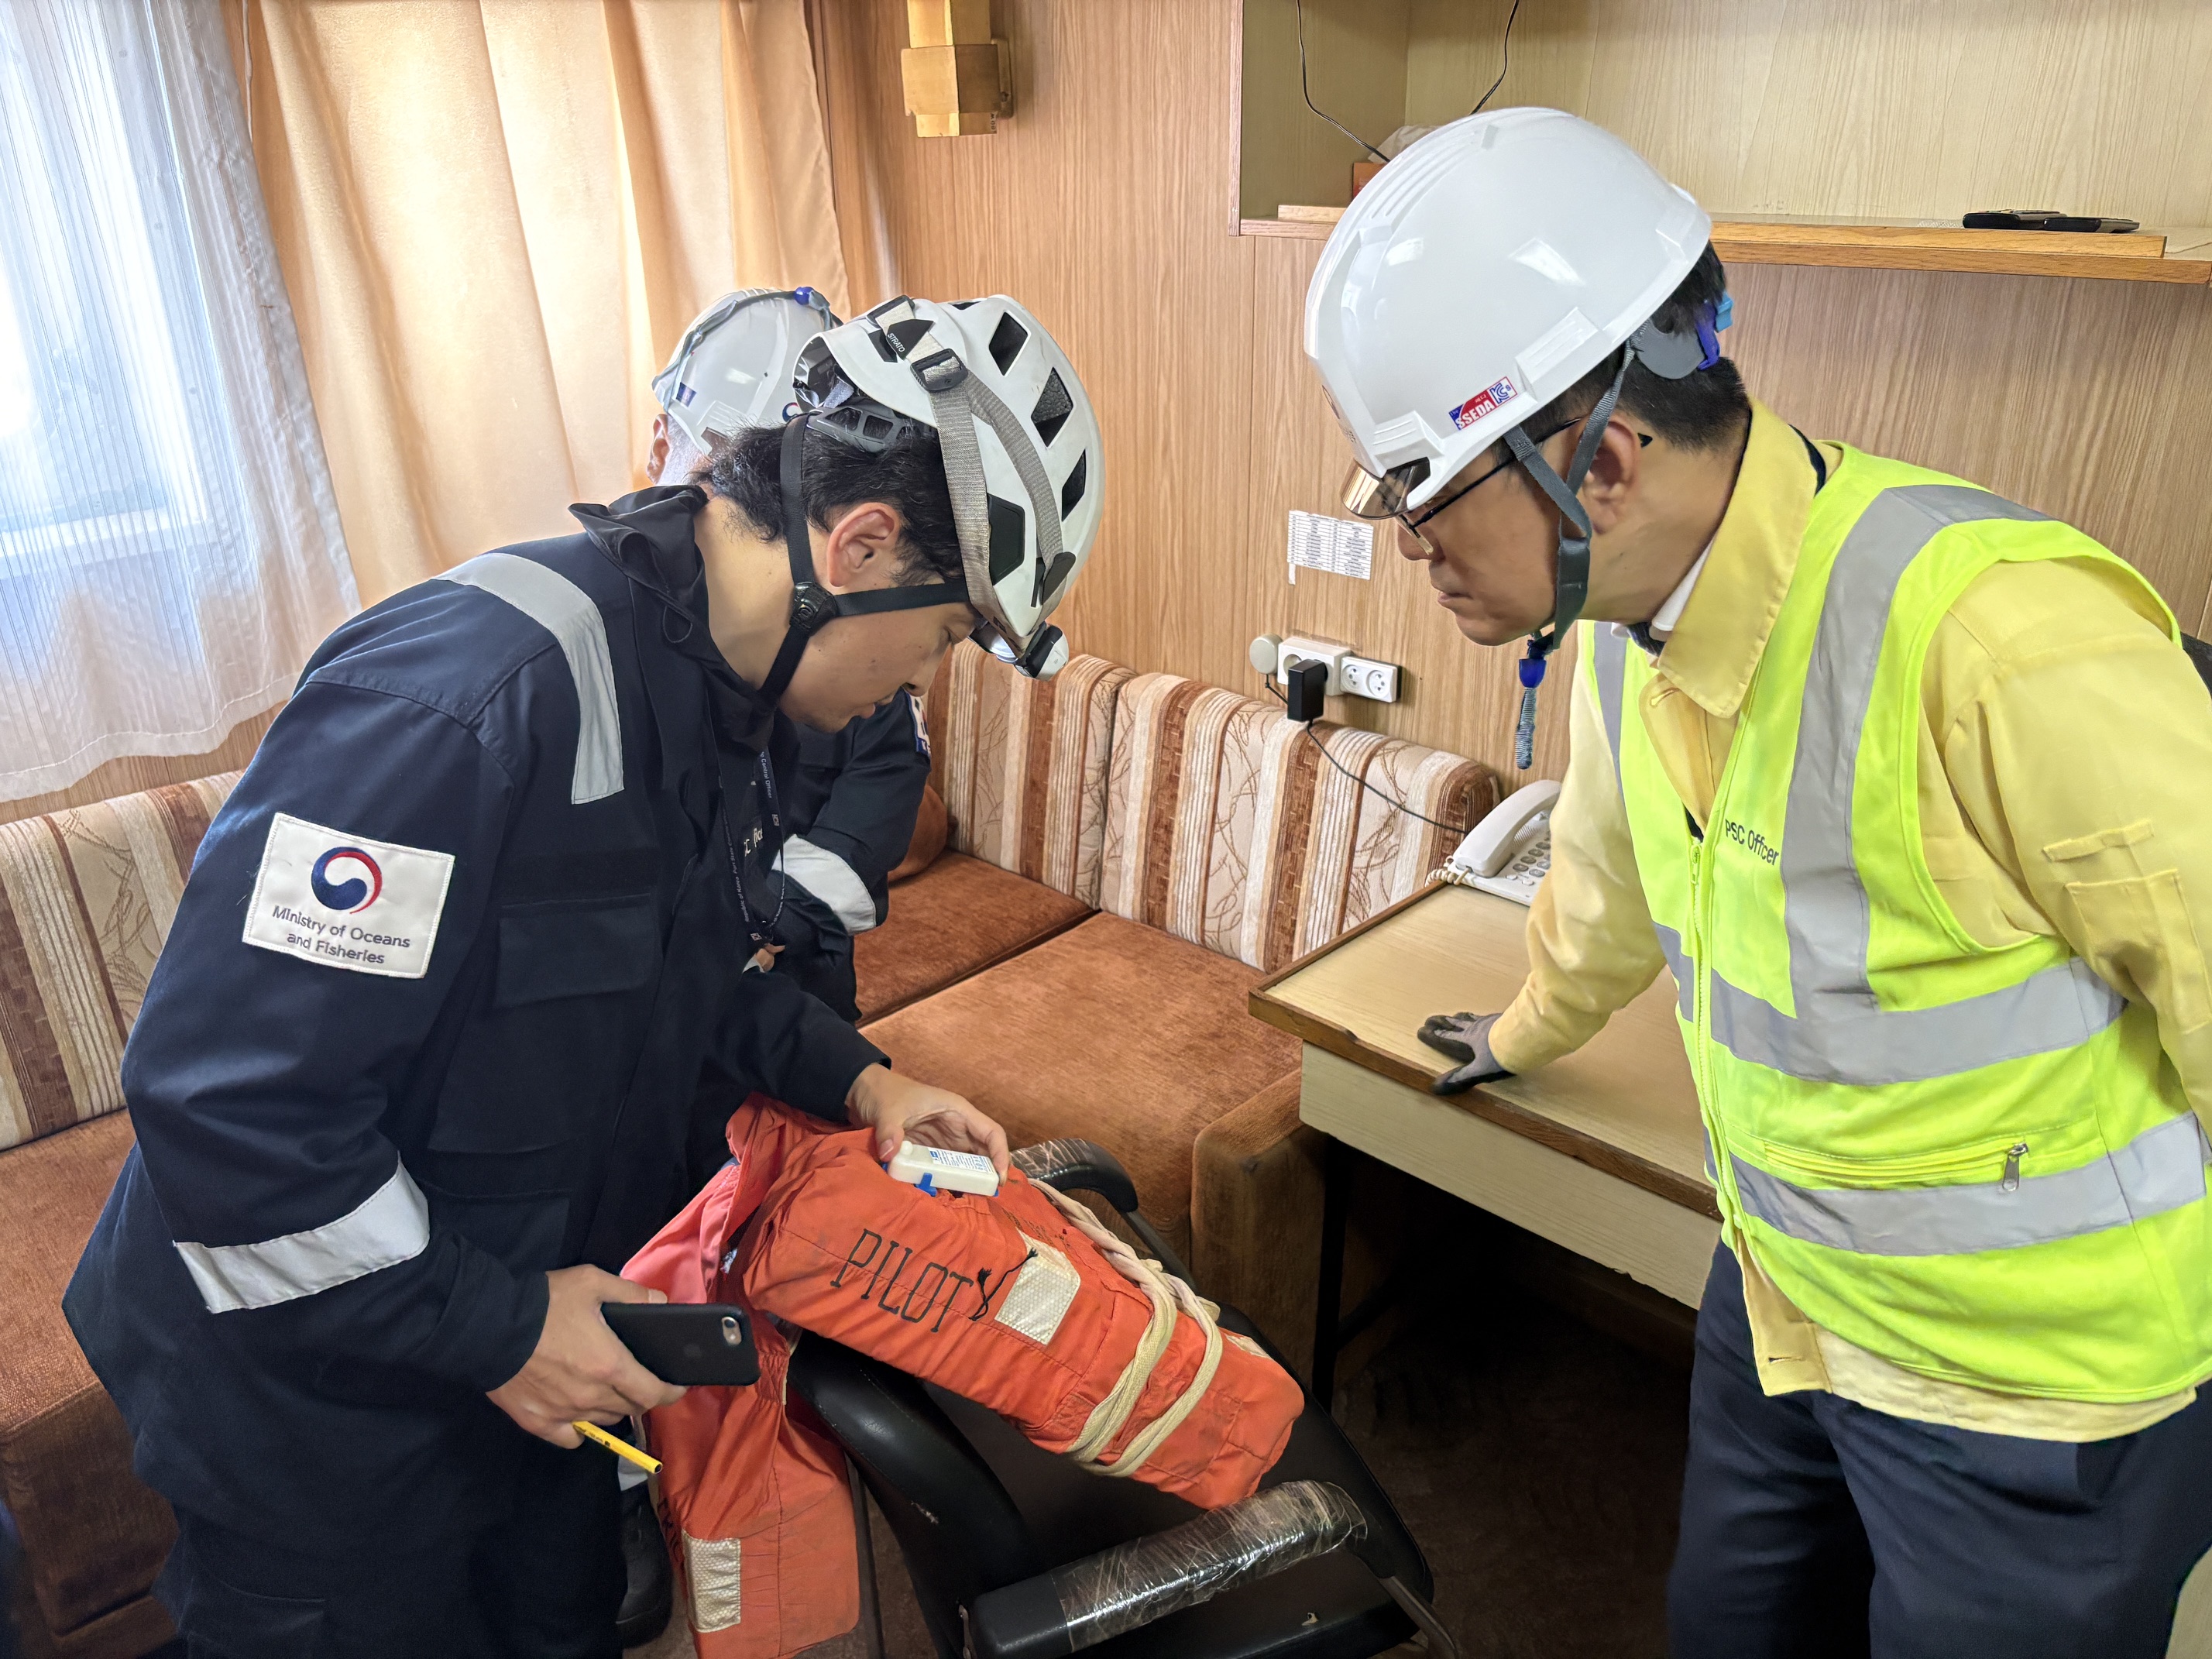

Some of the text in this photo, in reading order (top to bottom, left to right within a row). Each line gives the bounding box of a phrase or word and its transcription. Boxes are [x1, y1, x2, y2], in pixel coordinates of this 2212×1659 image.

[888, 333, 905, 352] STRATO
[1455, 399, 1496, 428] SSEDA
[1725, 819, 1779, 866] PSC Offcer
[272, 905, 410, 948] Ministry of Oceans
[287, 933, 385, 964] and Fisheries
[830, 1228, 974, 1333] PILOT
